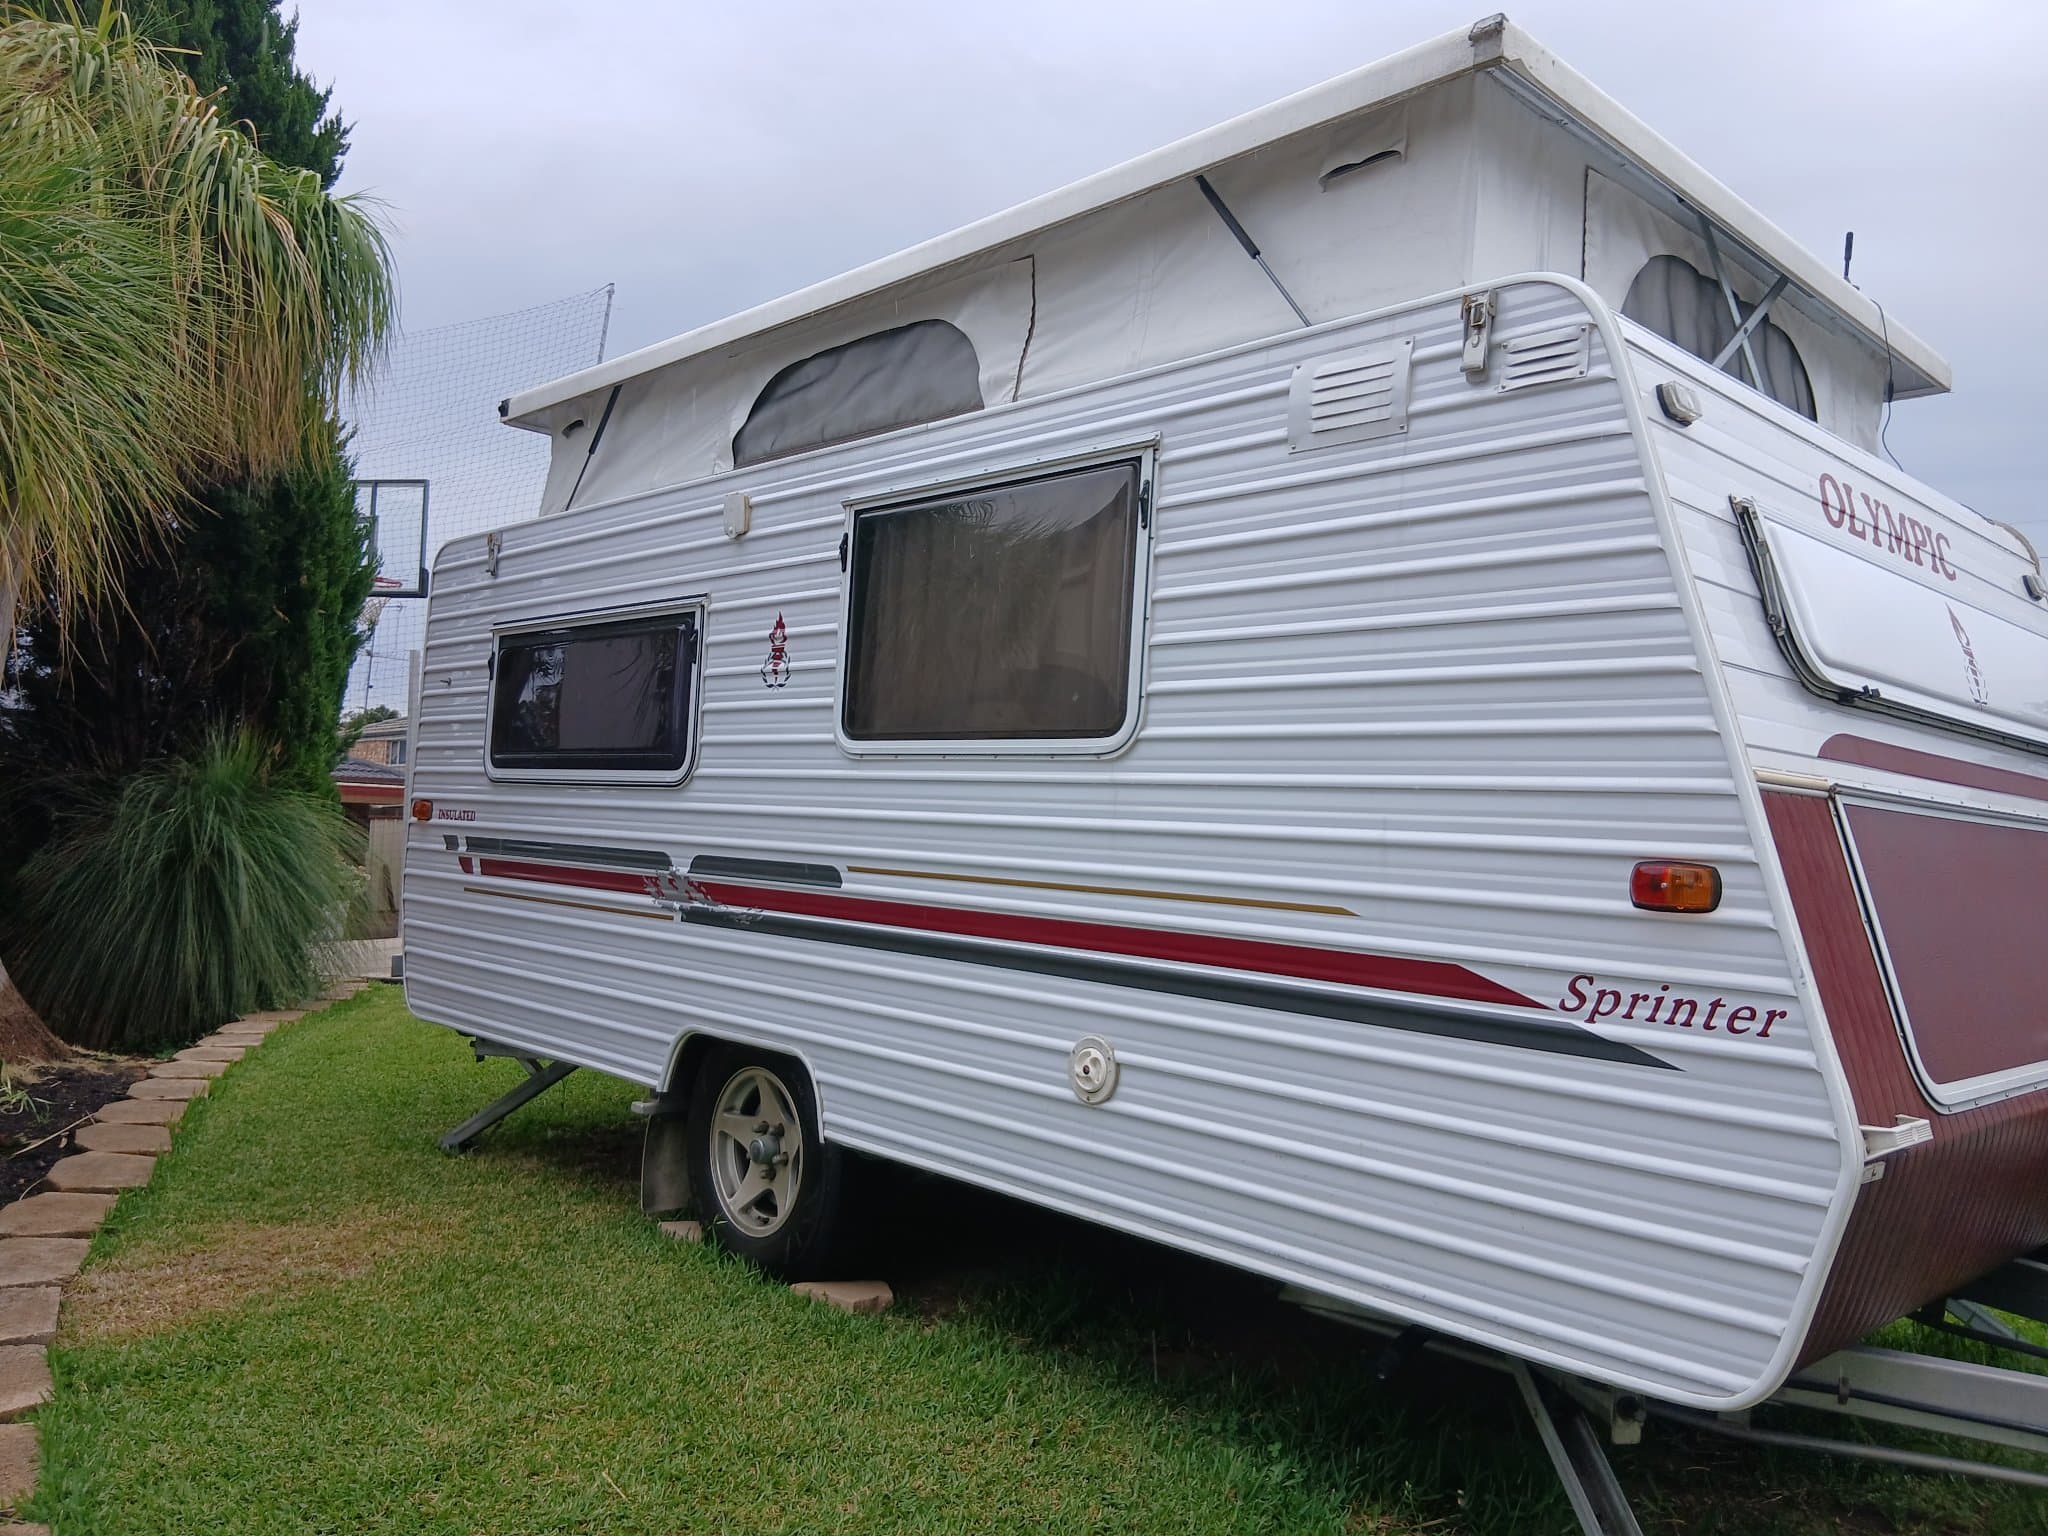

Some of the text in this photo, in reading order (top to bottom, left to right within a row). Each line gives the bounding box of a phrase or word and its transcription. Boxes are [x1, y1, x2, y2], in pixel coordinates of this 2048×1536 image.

[1818, 472, 1957, 581] OLYMPIC
[438, 809, 476, 821] INSULATED
[1558, 974, 1788, 1038] Sprinter
